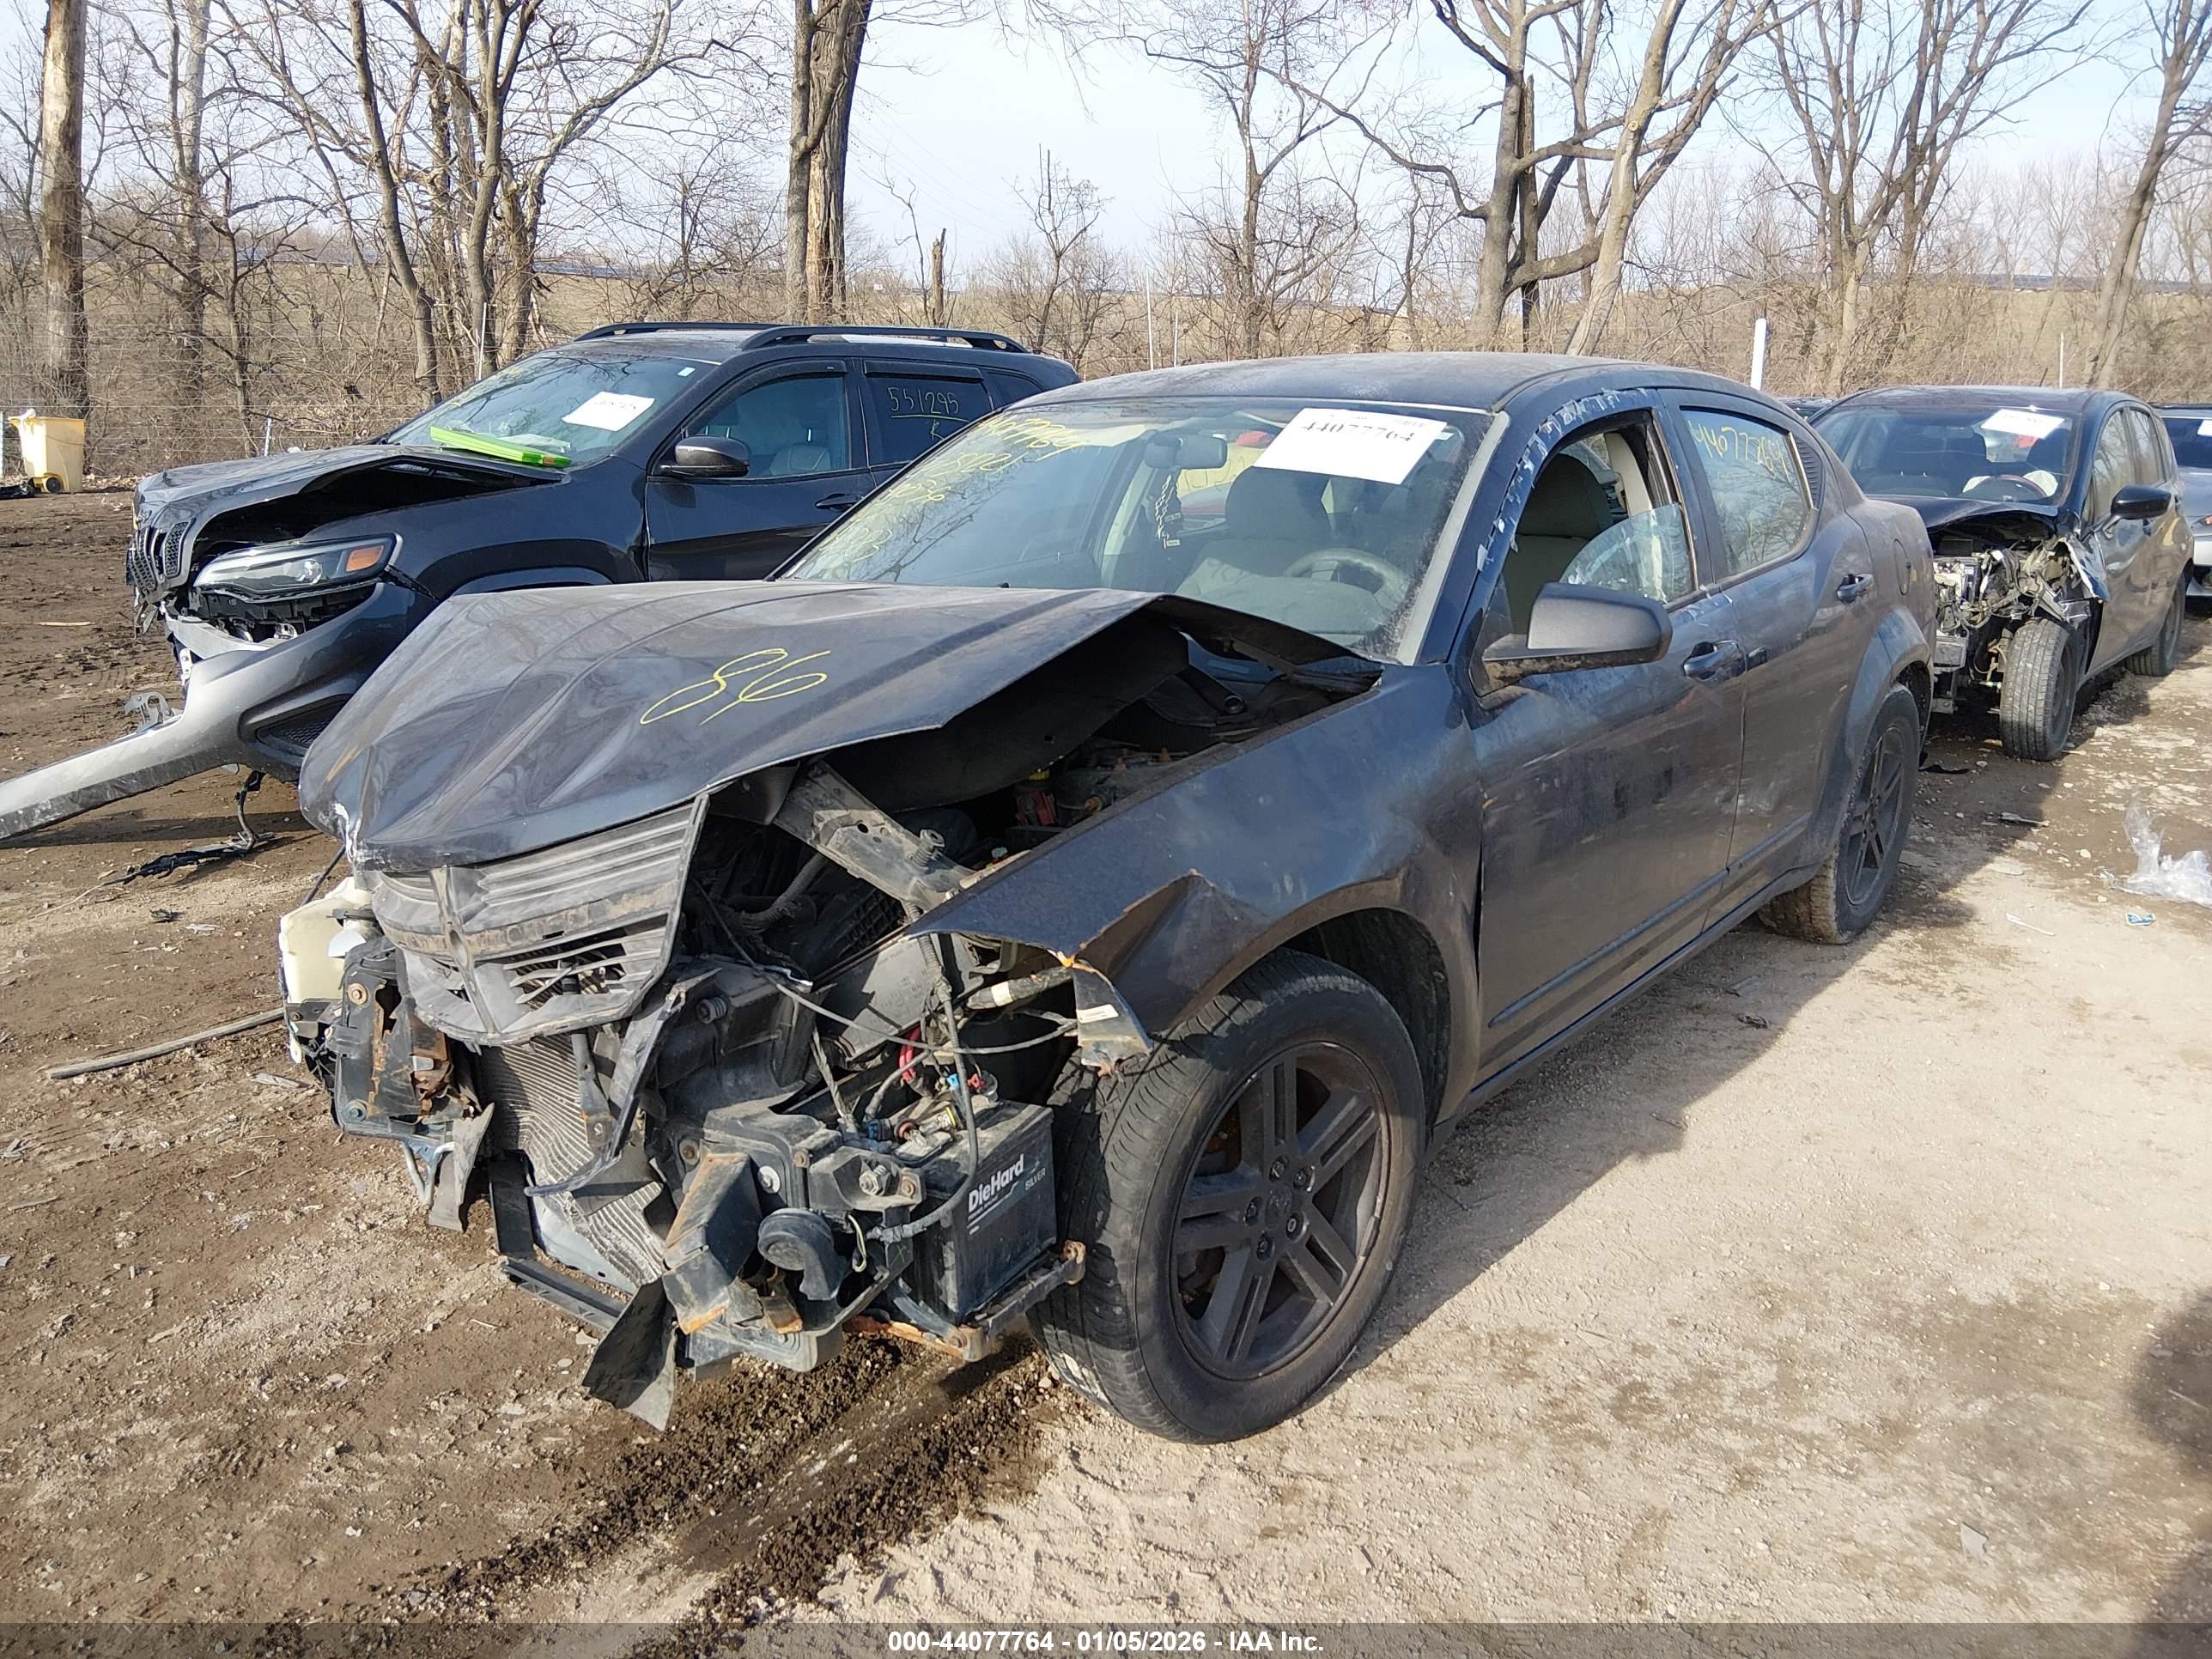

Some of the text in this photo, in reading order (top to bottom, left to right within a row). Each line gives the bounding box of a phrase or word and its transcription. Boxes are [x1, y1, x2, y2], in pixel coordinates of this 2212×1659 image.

[887, 386, 959, 415] 551295
[639, 647, 832, 726] 86
[968, 1153, 1024, 1213] DieHard
